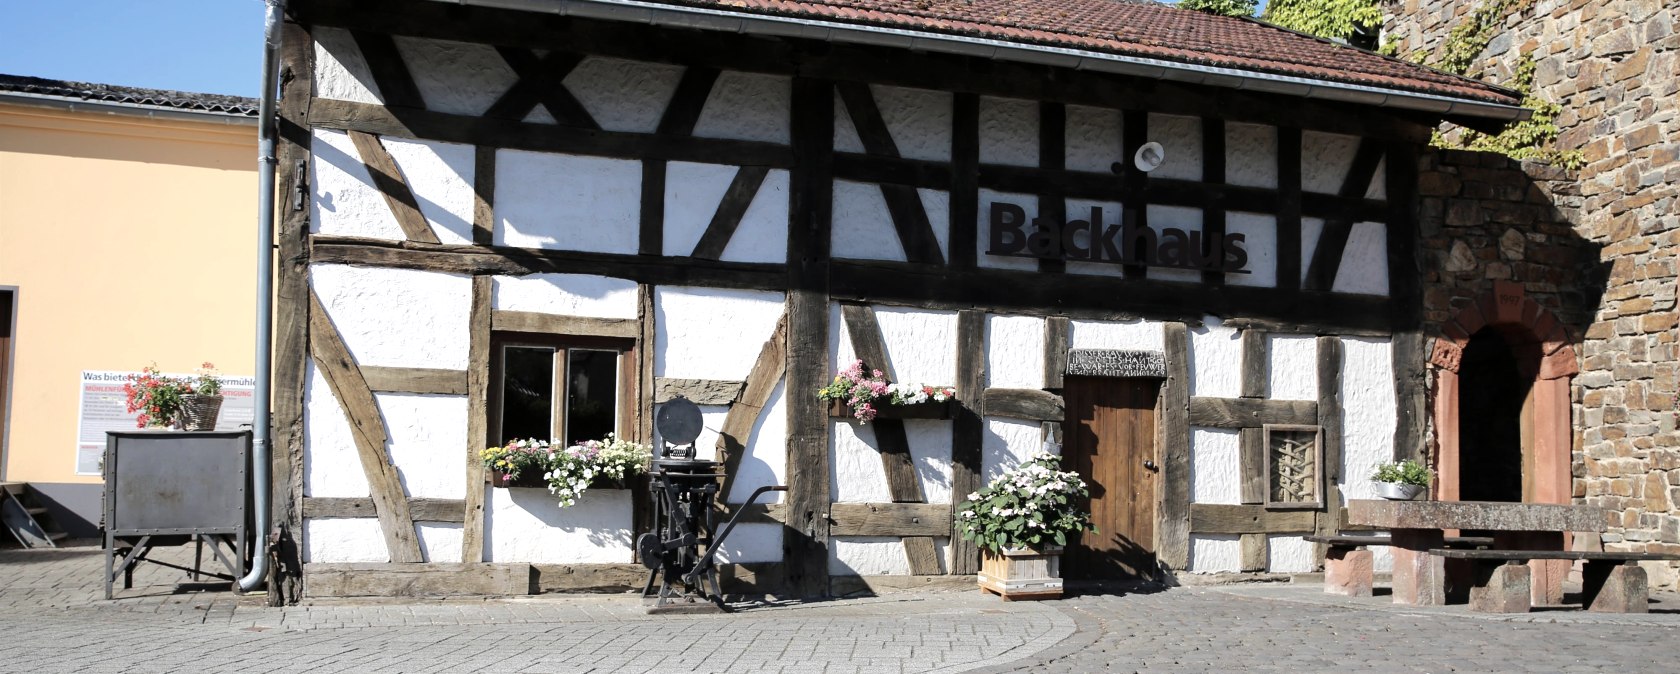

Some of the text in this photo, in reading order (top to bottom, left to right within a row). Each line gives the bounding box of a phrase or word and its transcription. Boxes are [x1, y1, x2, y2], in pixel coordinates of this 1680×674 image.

[990, 202, 1248, 270] Backhaus
[83, 372, 102, 381] Was
[104, 373, 131, 381] biete
[85, 385, 126, 394] MÜHLENFÜ
